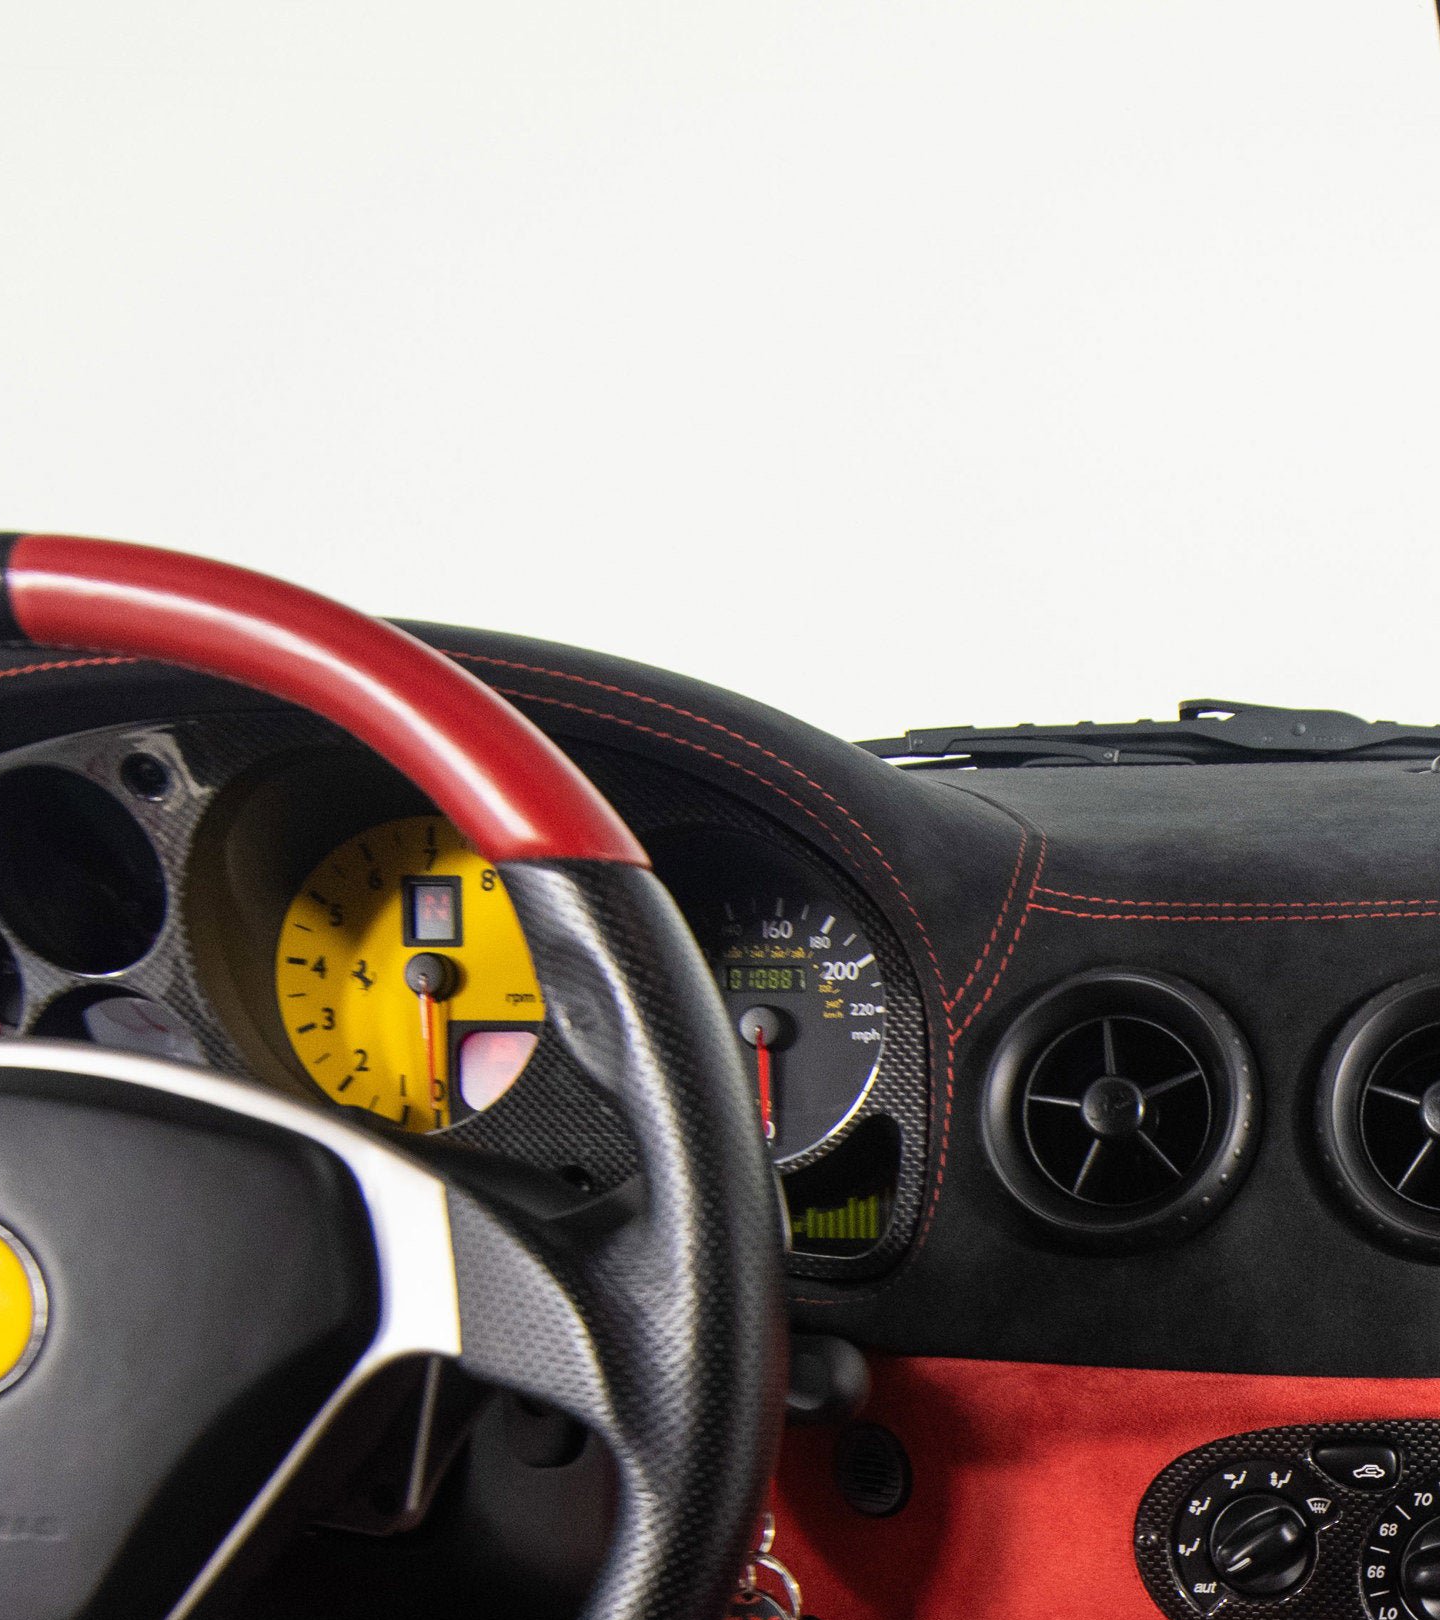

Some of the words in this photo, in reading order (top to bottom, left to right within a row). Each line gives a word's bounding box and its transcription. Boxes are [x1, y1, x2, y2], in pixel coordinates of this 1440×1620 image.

[481, 869, 495, 891] 8
[329, 904, 343, 927] 5
[762, 919, 793, 939] 160
[810, 935, 832, 949] 180
[311, 956, 327, 979] 4
[822, 961, 859, 981] 200
[849, 1003, 875, 1016] 220
[321, 1007, 335, 1030] 3
[851, 1028, 881, 1044] mph
[353, 1049, 369, 1072] 2
[1413, 1492, 1433, 1507] 70
[1379, 1523, 1399, 1537] 68
[1366, 1565, 1386, 1579] 66
[1193, 1581, 1218, 1594] aut
[1378, 1607, 1398, 1620] LO
